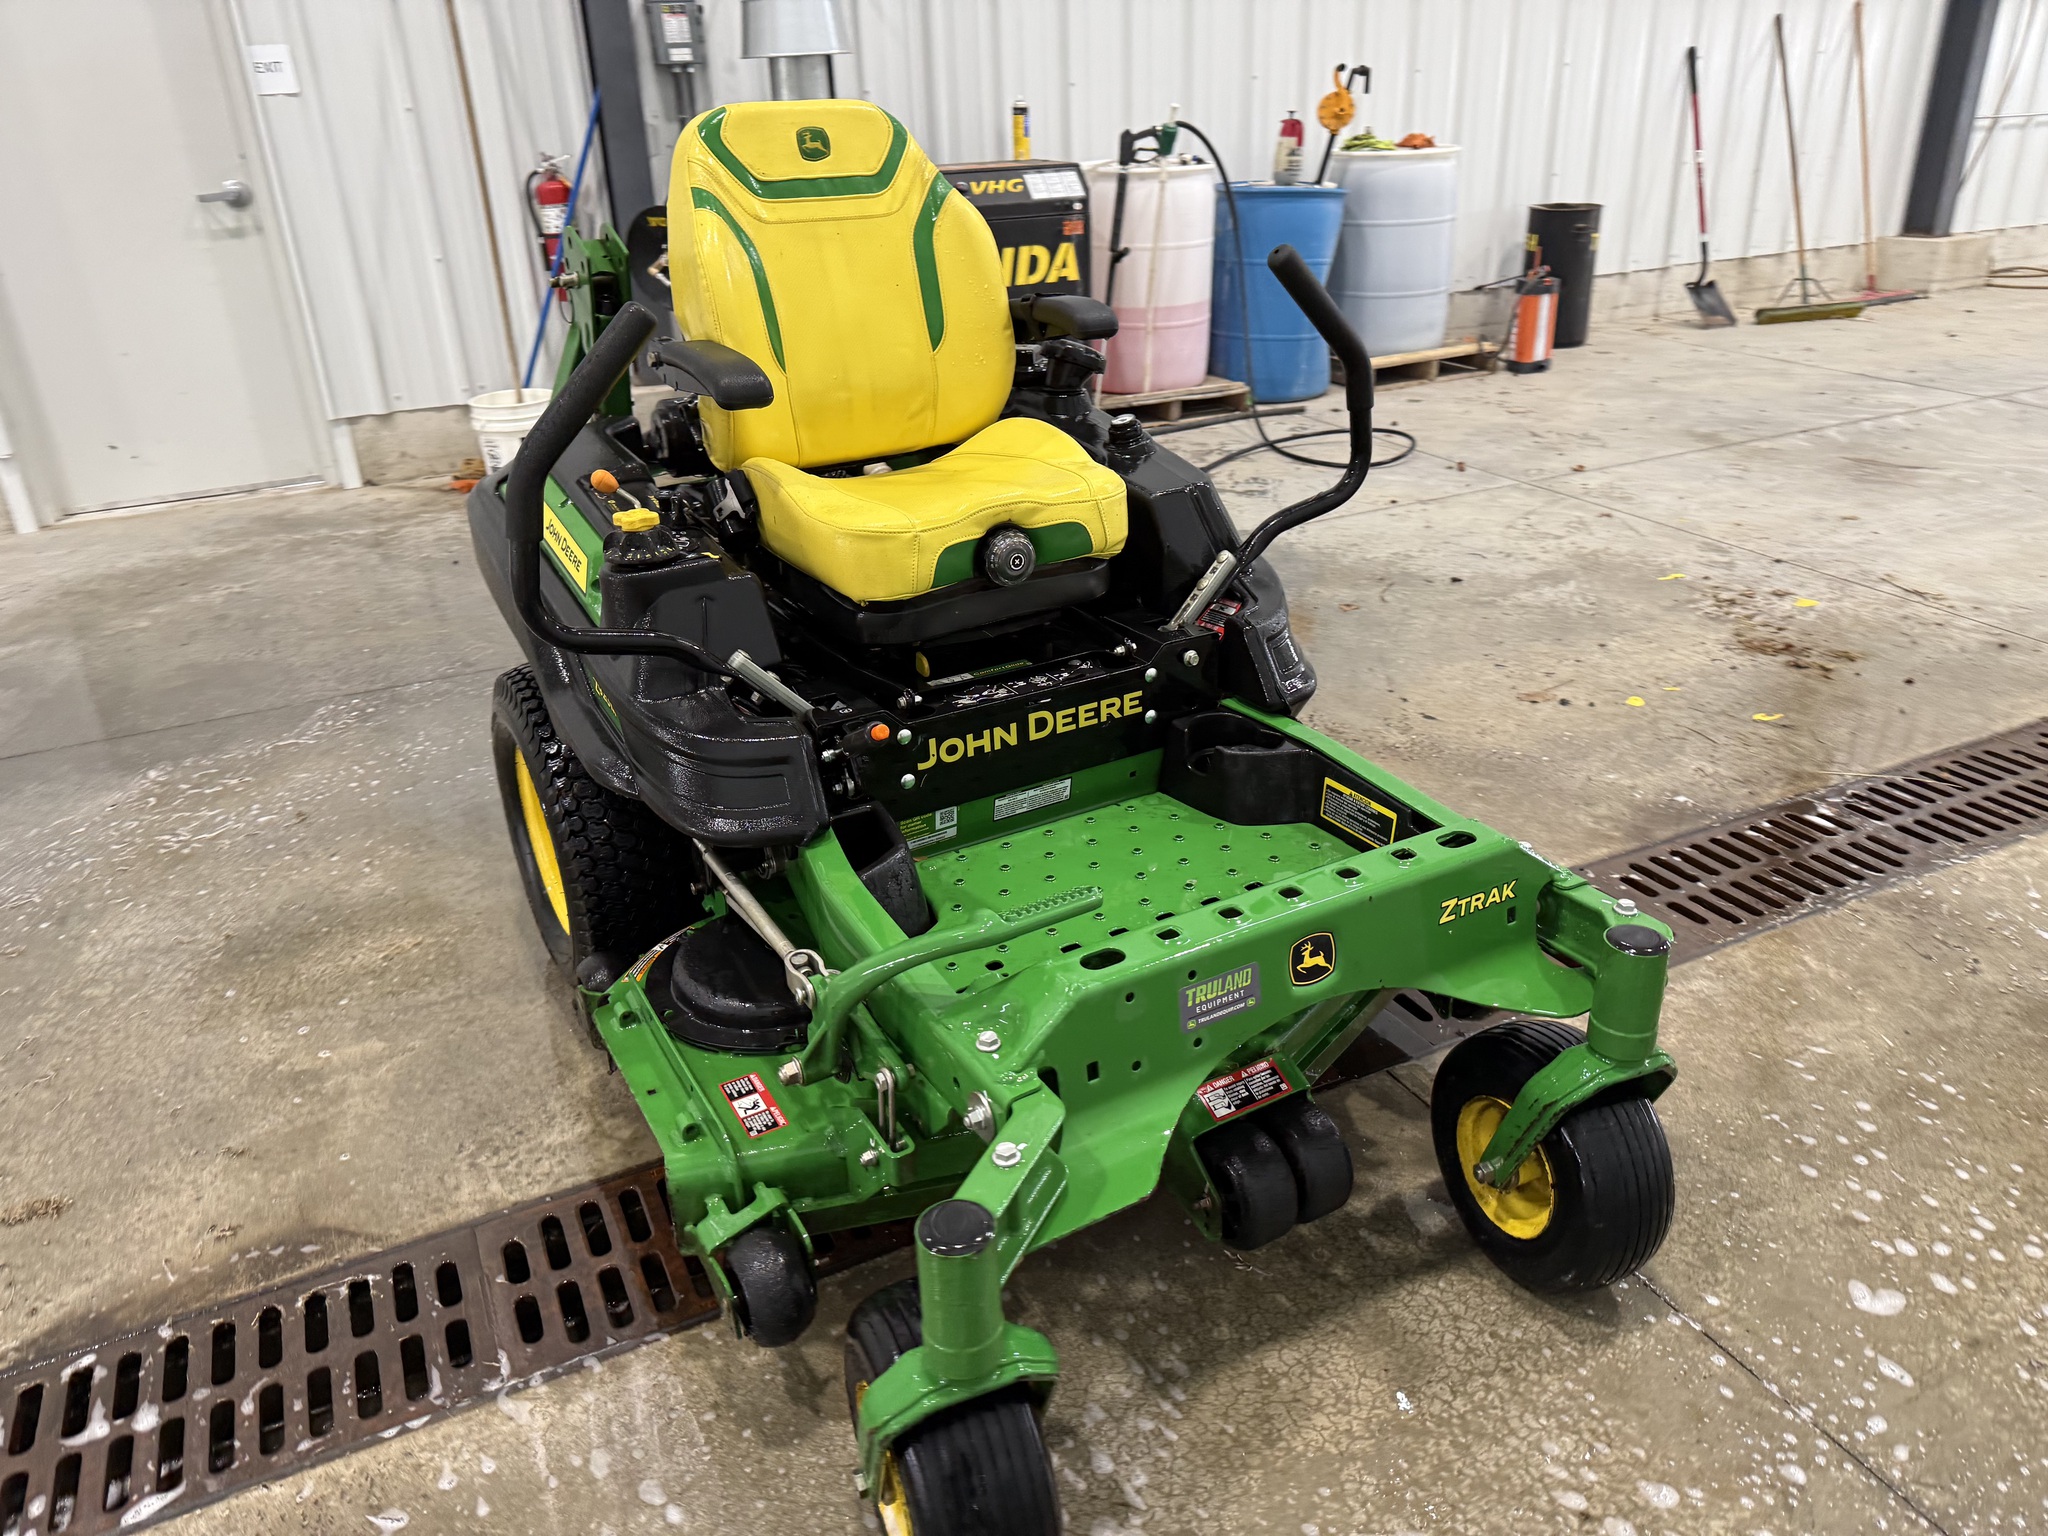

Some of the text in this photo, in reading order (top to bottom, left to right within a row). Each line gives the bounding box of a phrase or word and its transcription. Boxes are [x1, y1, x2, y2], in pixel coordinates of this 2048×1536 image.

[252, 61, 284, 74] EXIT
[969, 178, 1025, 196] VHG
[546, 519, 582, 573] JOHN DEERE
[917, 690, 1143, 771] JOHN DEERE
[1438, 878, 1518, 925] ZTRAK
[1185, 967, 1252, 1008] TRULAND
[1196, 989, 1245, 1014] EQUIPMENT
[1198, 1002, 1246, 1024] TRULANDEQUIP.COM
[1213, 1075, 1235, 1089] DANGER
[1246, 1061, 1269, 1075] PELIGRO
